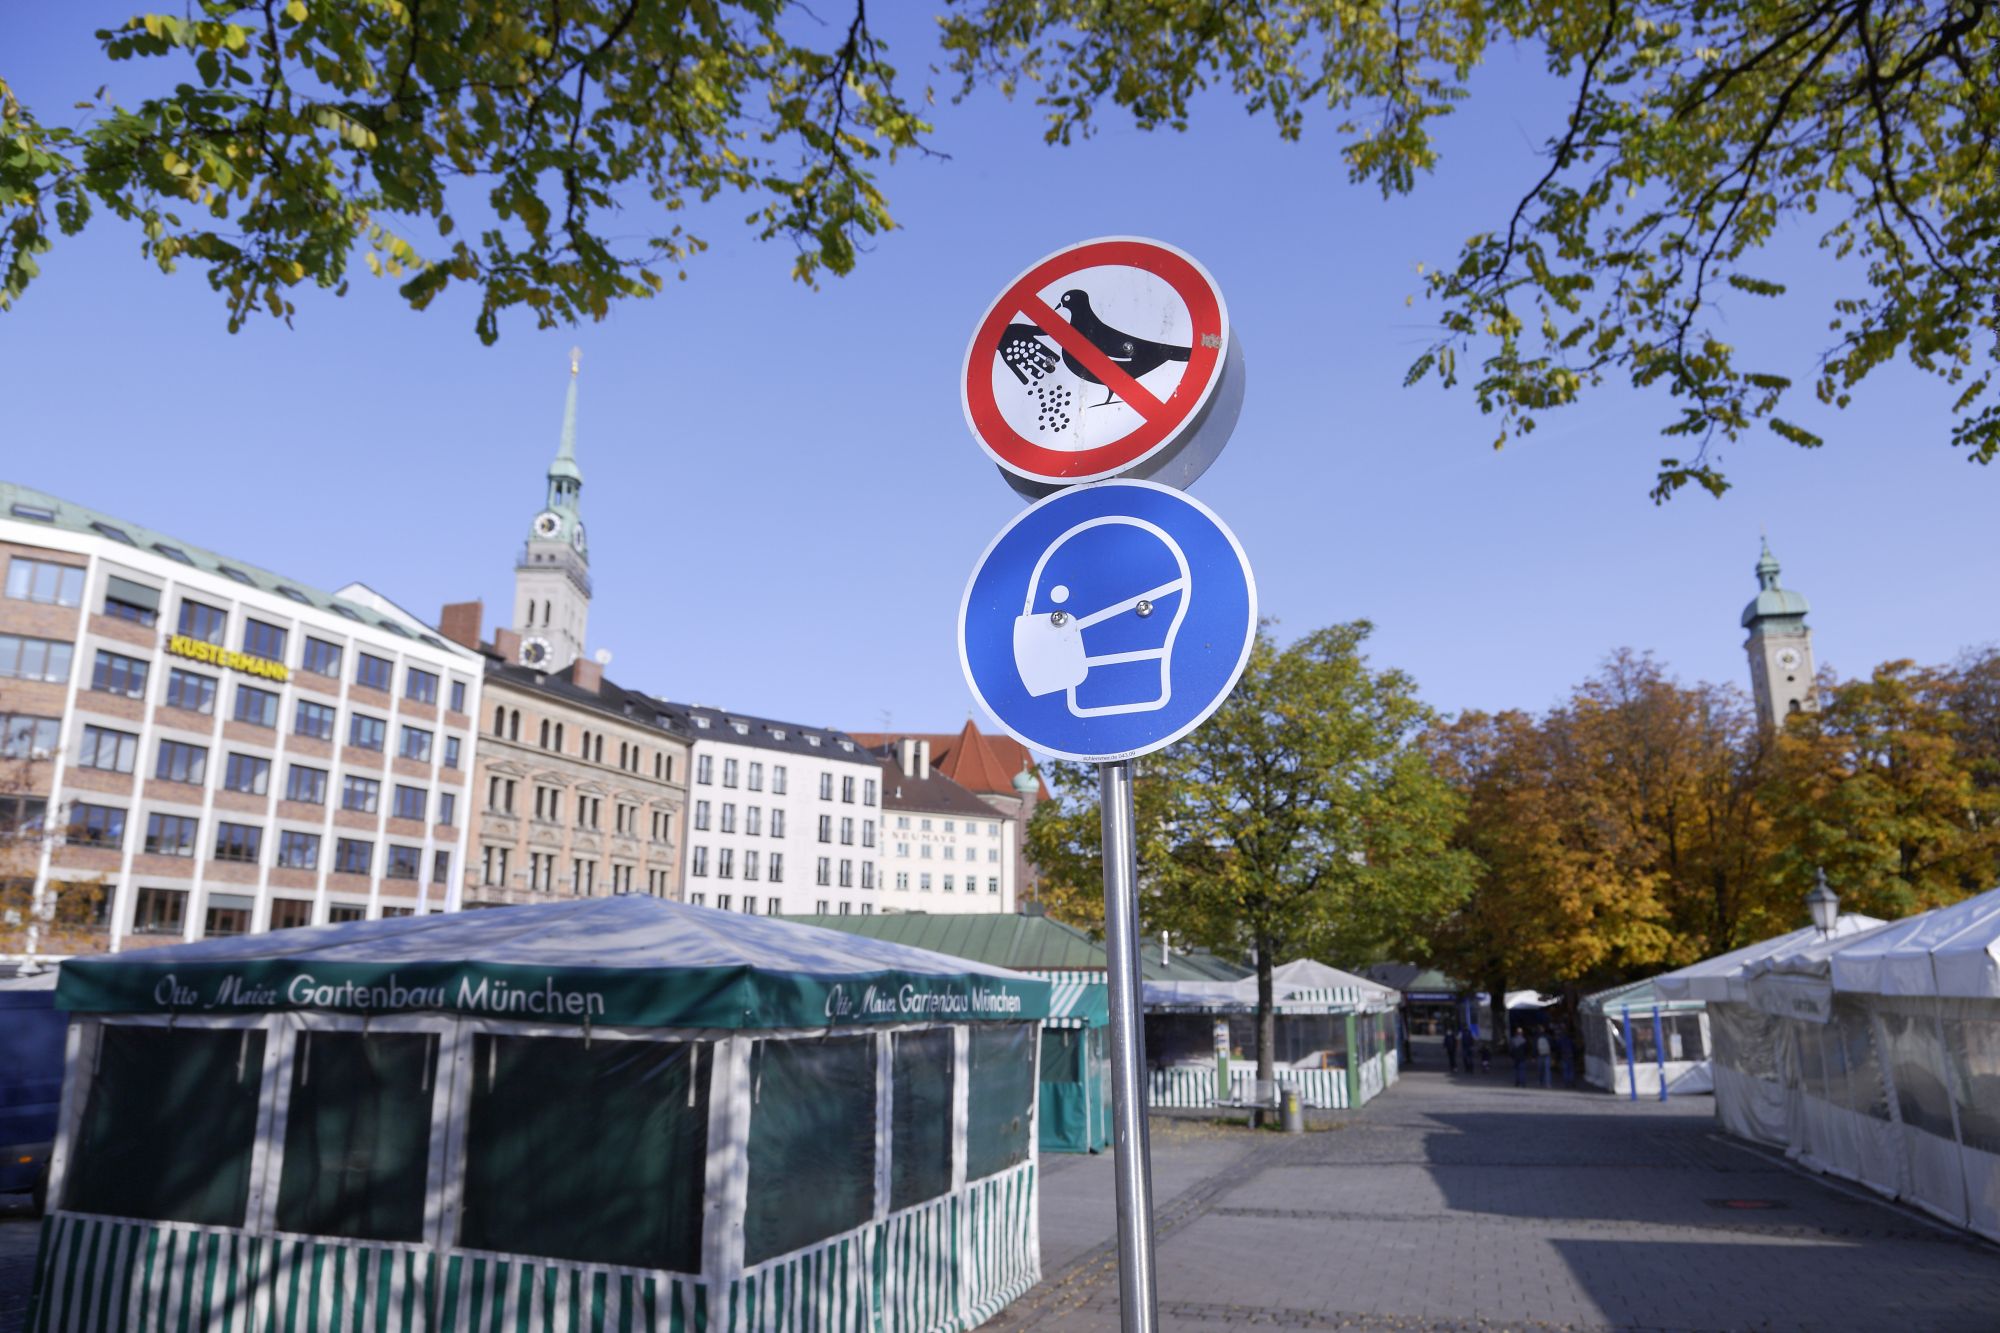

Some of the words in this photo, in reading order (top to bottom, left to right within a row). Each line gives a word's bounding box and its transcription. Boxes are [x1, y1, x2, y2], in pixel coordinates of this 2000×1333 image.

[168, 634, 290, 682] KUSTERMANN
[154, 973, 199, 1006] Otto
[203, 974, 277, 1009] Maier
[287, 973, 445, 1009] Gartenbau
[456, 975, 605, 1015] München
[825, 983, 852, 1018] Otto
[852, 984, 897, 1019] Maier
[899, 983, 969, 1014] Gartenbau
[971, 985, 1021, 1013] München
